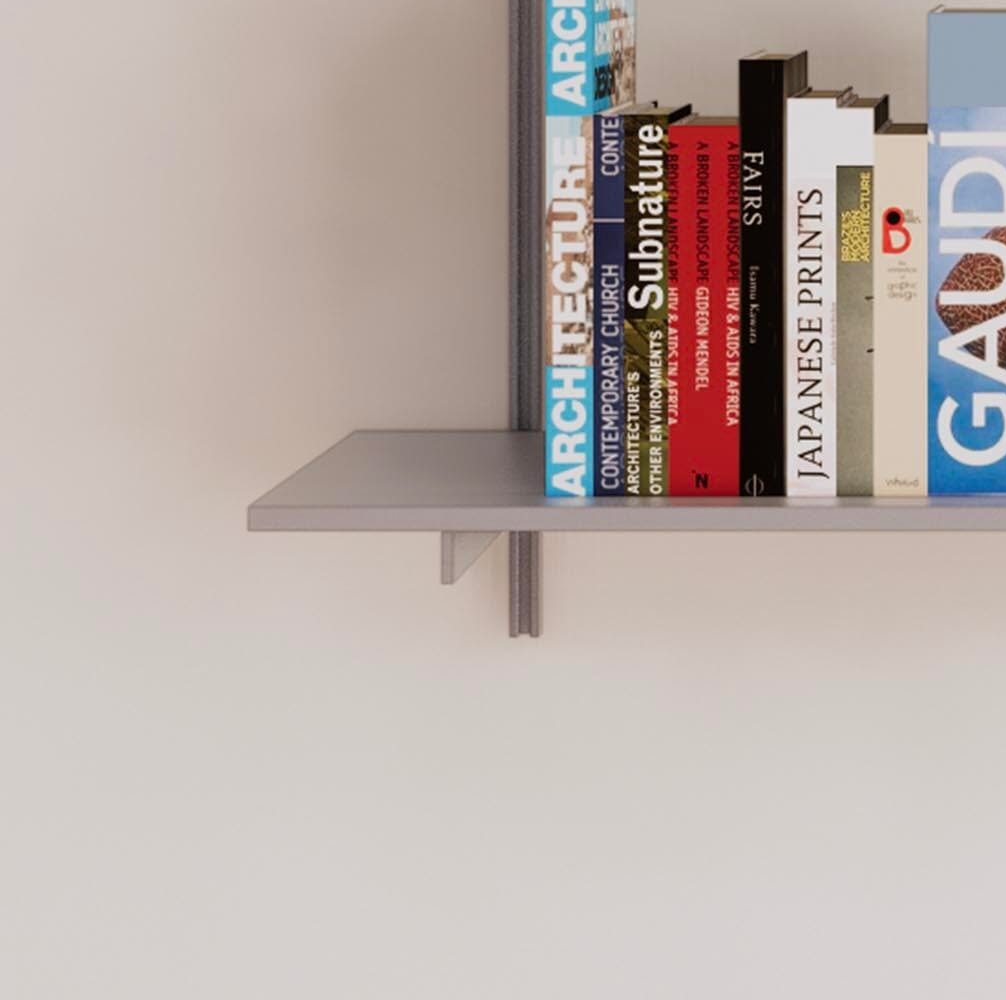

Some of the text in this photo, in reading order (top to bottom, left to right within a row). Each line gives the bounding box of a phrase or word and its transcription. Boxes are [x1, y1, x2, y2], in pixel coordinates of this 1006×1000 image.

[628, 124, 663, 311] Subnature
[695, 141, 709, 390] A BROKEN LANDSCAPE GIDEON MENDEL
[726, 141, 739, 426] A BROKEN LANDSCAPE HIV & AIDS IN AFRICA
[743, 151, 764, 226] FAIRS
[860, 171, 871, 263] ARCHITECTURE
[552, 136, 588, 496] ARCHITECTURE
[601, 264, 619, 489] CONTEMPORARY CHURCH
[649, 330, 663, 495] OTHER ENVIRONMENTS
[797, 188, 829, 479] JAPANESE PRINTS
[627, 371, 640, 494] ARCHITECTURE'S
